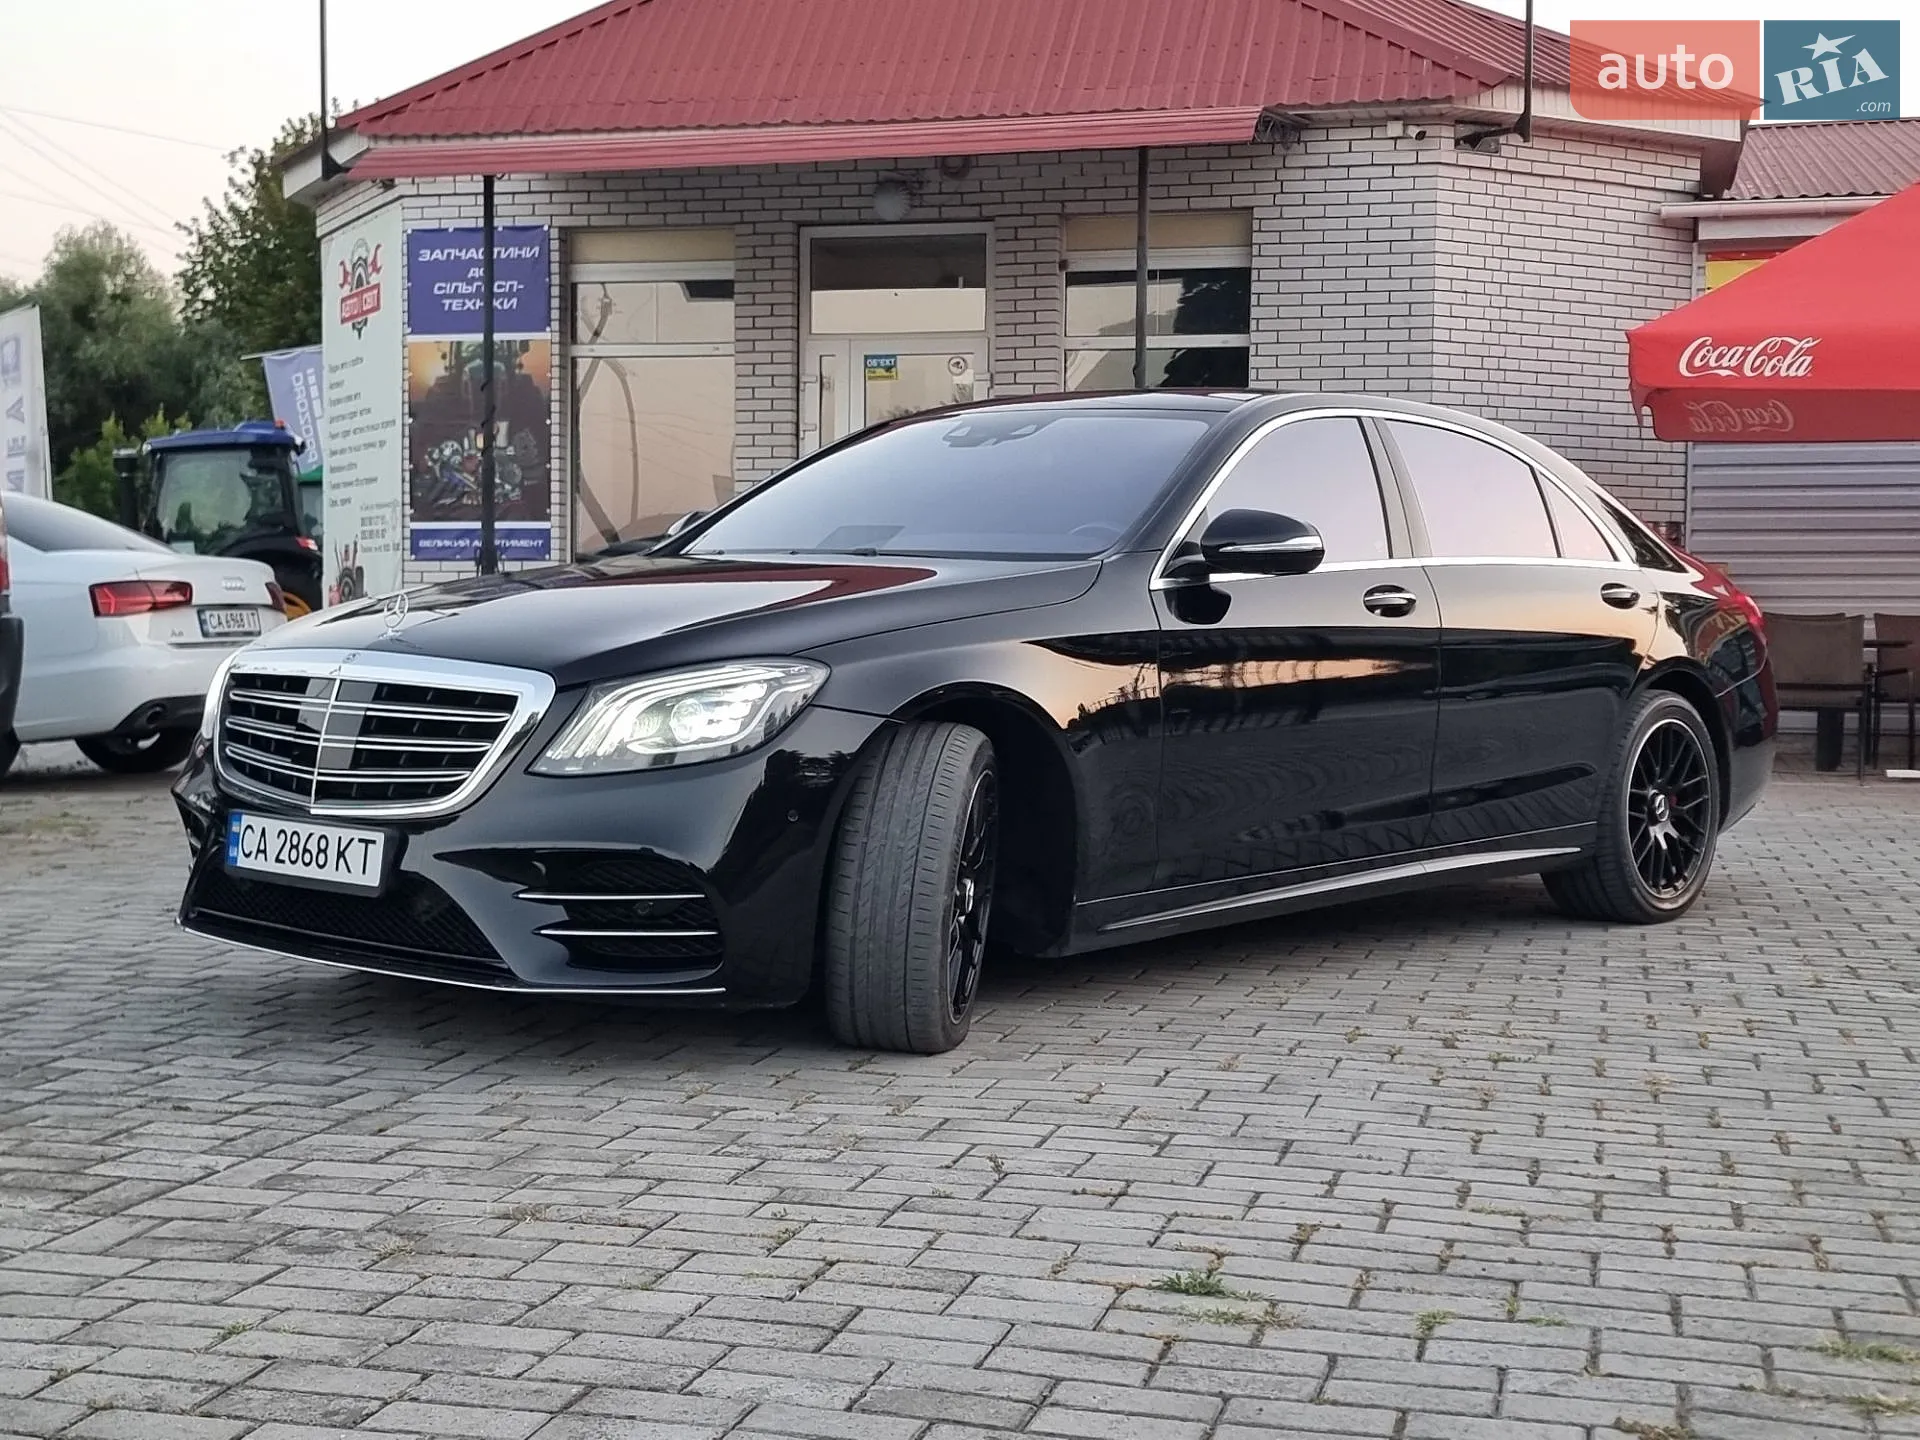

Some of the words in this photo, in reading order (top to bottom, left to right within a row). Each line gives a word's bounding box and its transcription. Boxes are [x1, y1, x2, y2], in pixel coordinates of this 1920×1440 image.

[432, 280, 525, 295] СІЛЬГСП-
[441, 297, 519, 312] ТЕХНКИ
[1679, 336, 1822, 378] Coca-Cola
[240, 824, 268, 863] CA
[274, 828, 330, 870] 2868
[334, 835, 378, 876] KT
